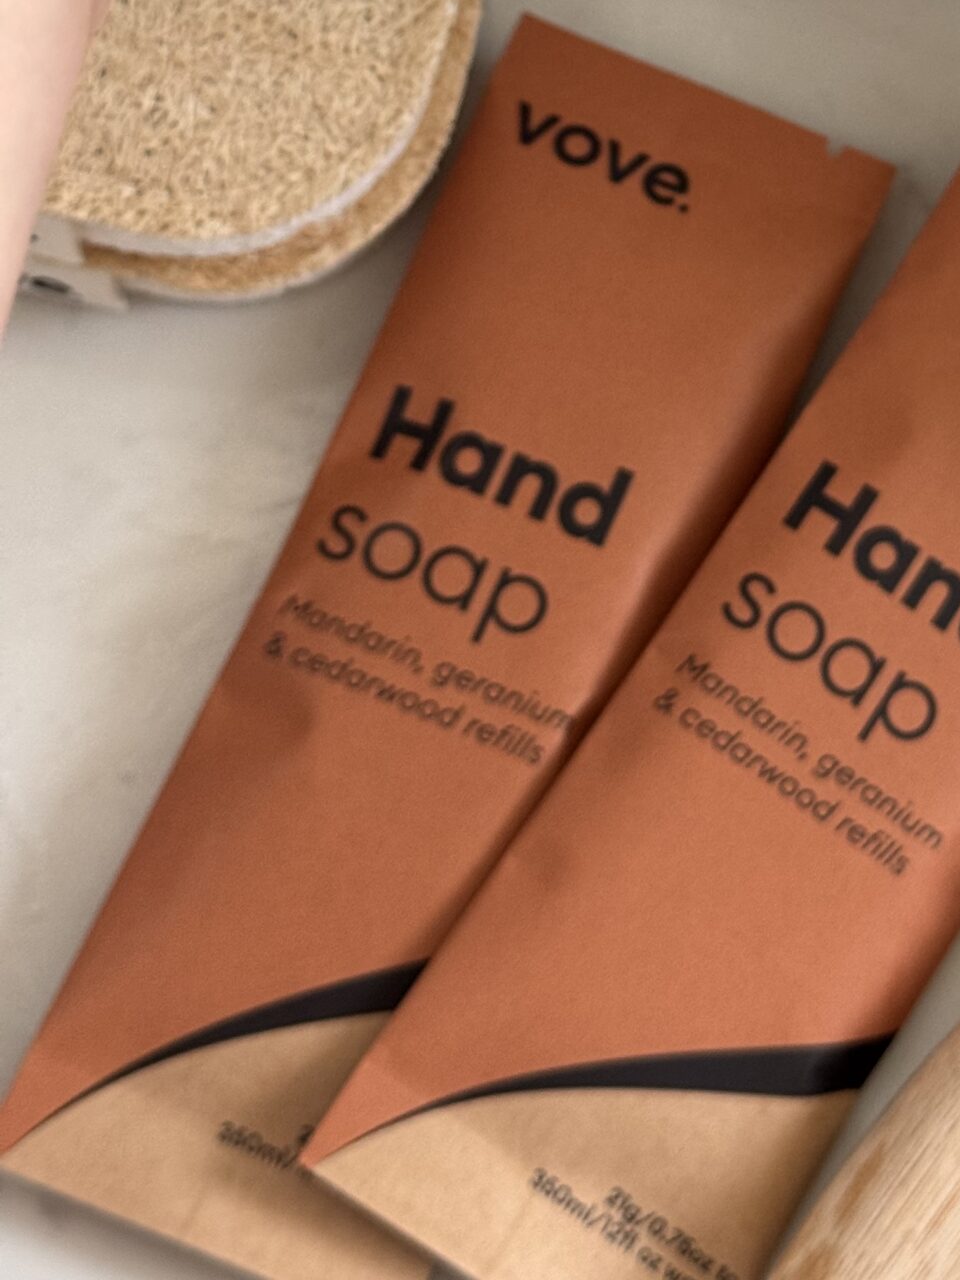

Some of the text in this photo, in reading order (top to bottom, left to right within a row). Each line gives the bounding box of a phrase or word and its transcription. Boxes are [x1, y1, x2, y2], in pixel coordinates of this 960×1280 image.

[518, 99, 690, 214] vove.
[370, 385, 635, 548] Hand
[316, 505, 547, 644] soap
[264, 631, 545, 765] & cedarwood refills
[279, 594, 573, 729] Mandarin, geranium
[722, 572, 937, 743] soap
[654, 687, 911, 875] & cedarwood refills
[675, 654, 943, 849] Mandarin, geranium
